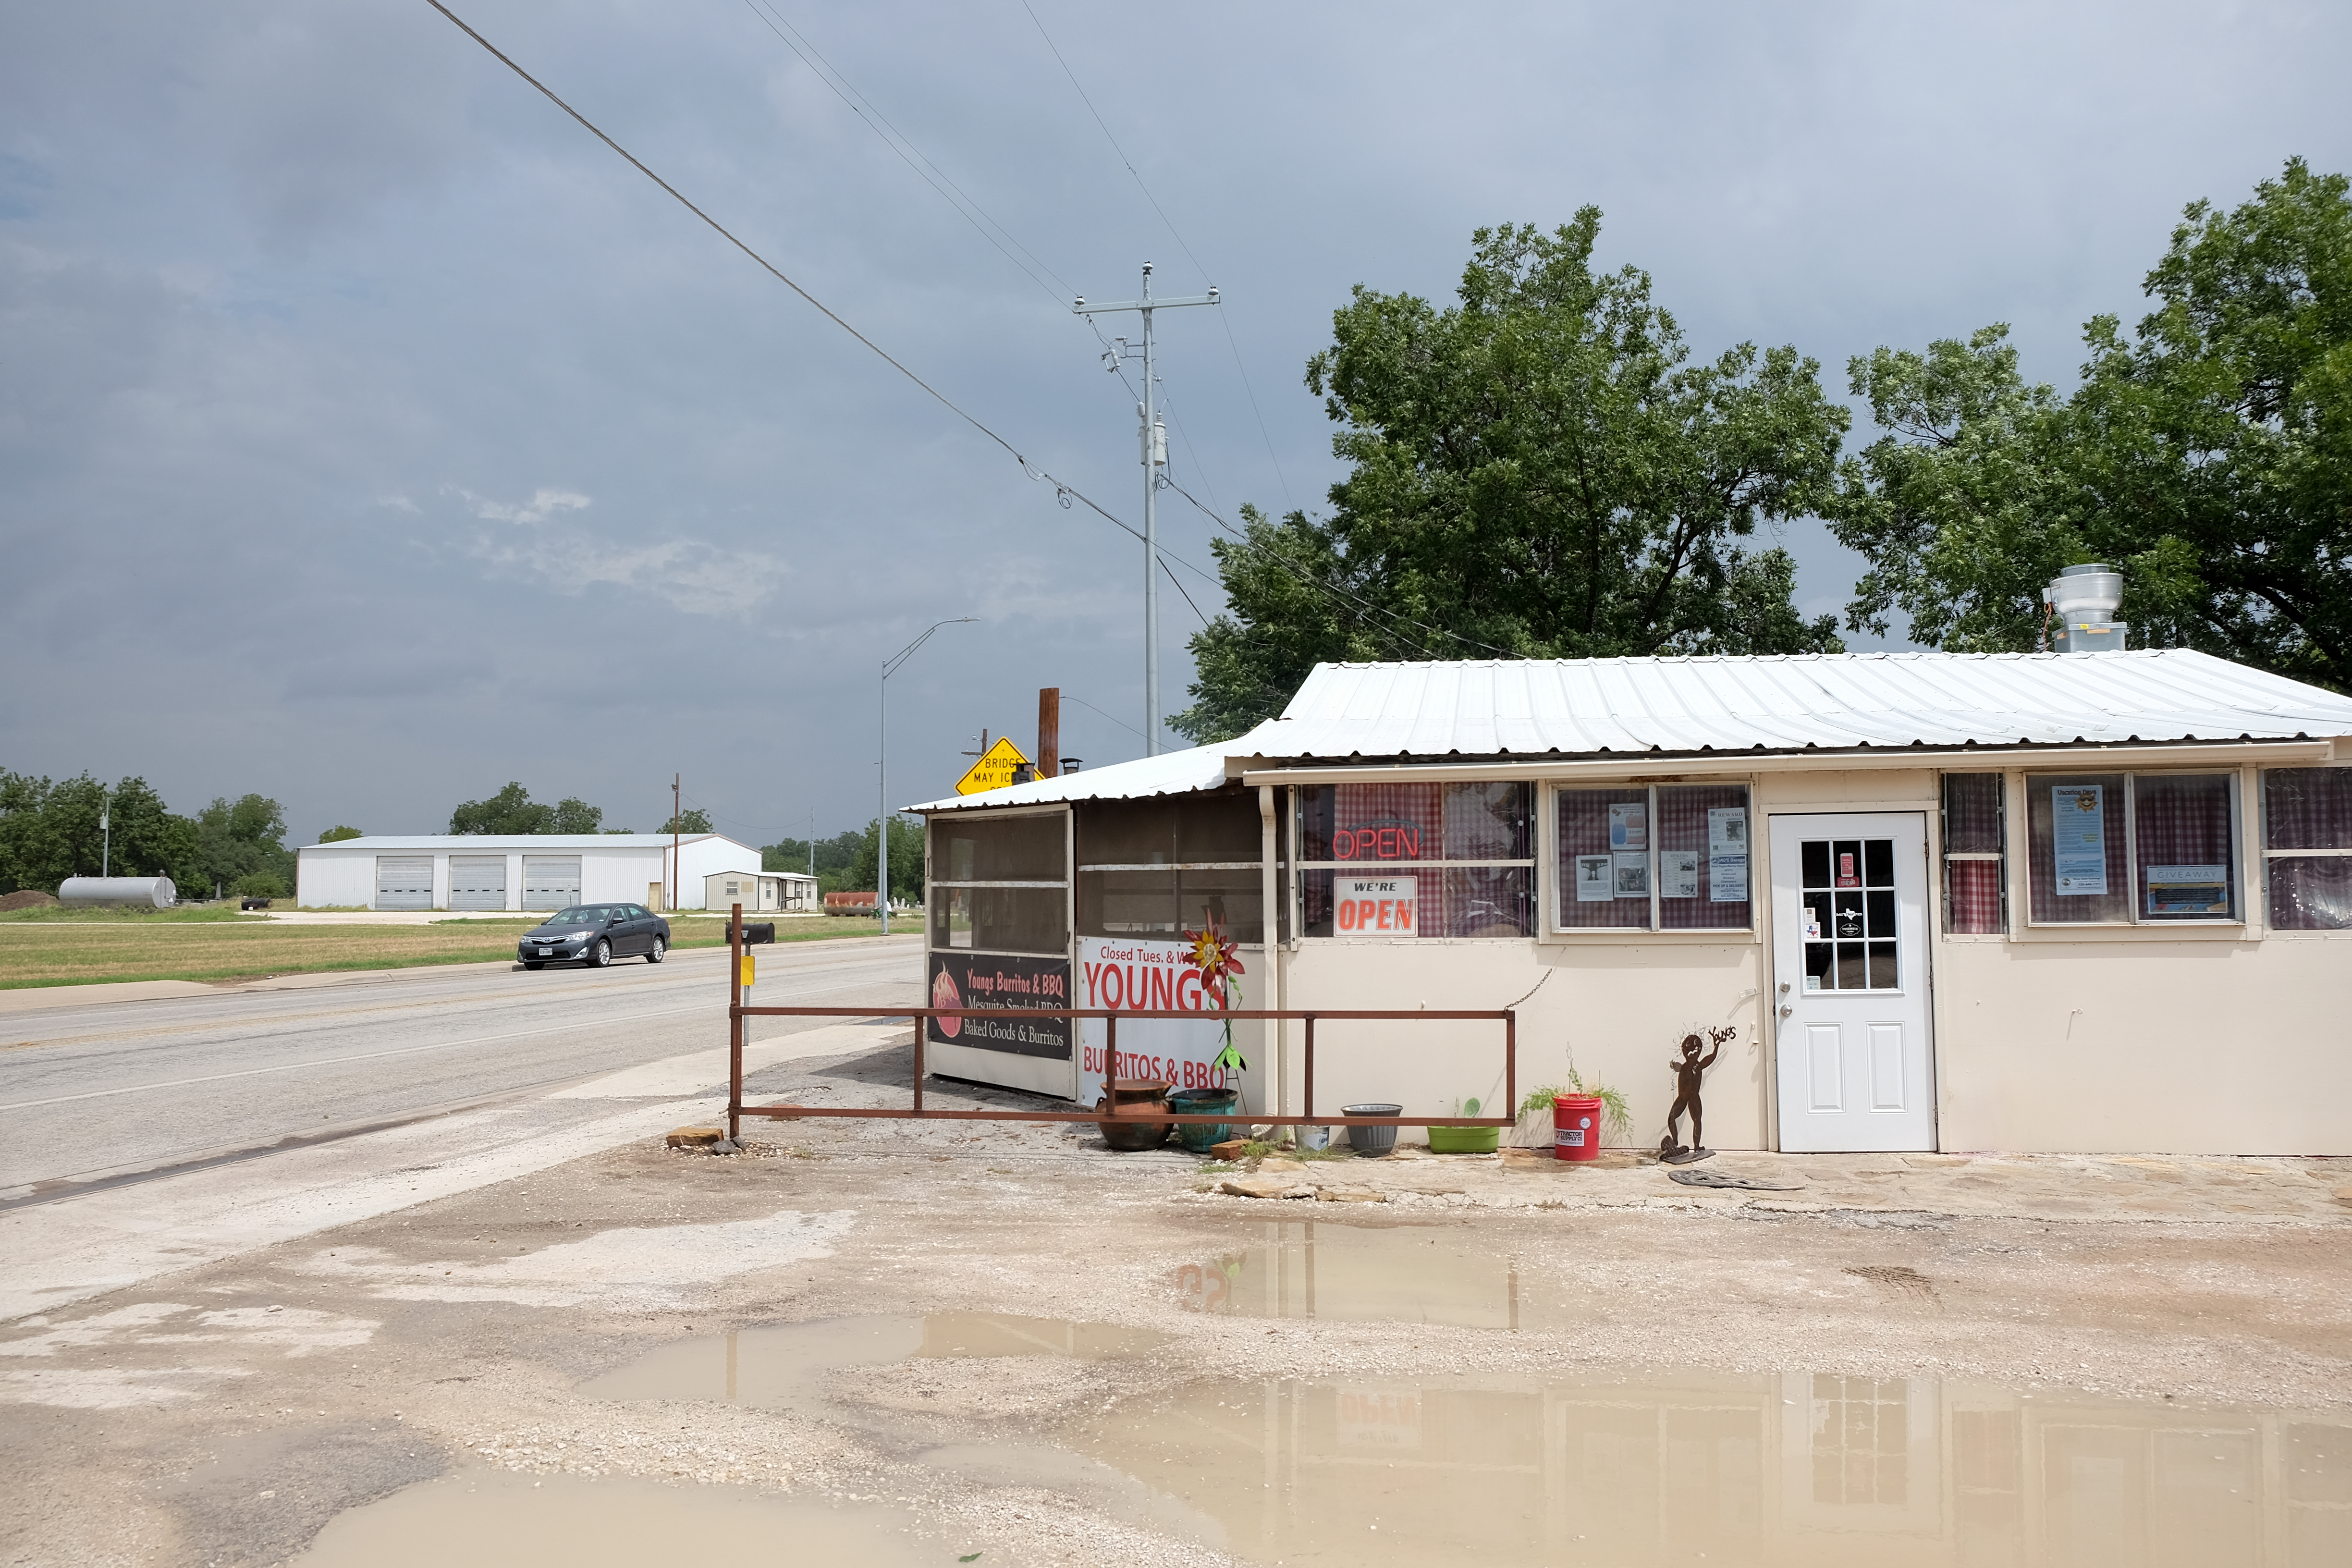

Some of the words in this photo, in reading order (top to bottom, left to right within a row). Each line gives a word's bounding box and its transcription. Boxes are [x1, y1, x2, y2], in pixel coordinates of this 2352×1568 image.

[974, 772, 993, 782] MAY
[1001, 772, 1013, 782] IC
[1333, 828, 1418, 859] OPEN
[1354, 882, 1397, 892] WE'RE
[1338, 899, 1413, 931] OPEN
[1101, 946, 1133, 961] Closed
[1137, 949, 1164, 963] Tues.
[1166, 951, 1174, 963] &
[967, 968, 993, 996] Youngs
[997, 971, 1030, 993] Burritos
[1033, 973, 1040, 994] &
[1042, 974, 1064, 998] BBQ
[968, 995, 1004, 1009] Mesquite
[964, 1018, 987, 1037] Baked
[989, 1021, 1015, 1041] Goods
[1018, 1025, 1027, 1042] &
[1029, 1026, 1064, 1046] Burritos
[1084, 1046, 1161, 1079] BURITOS
[1165, 1058, 1179, 1087] &
